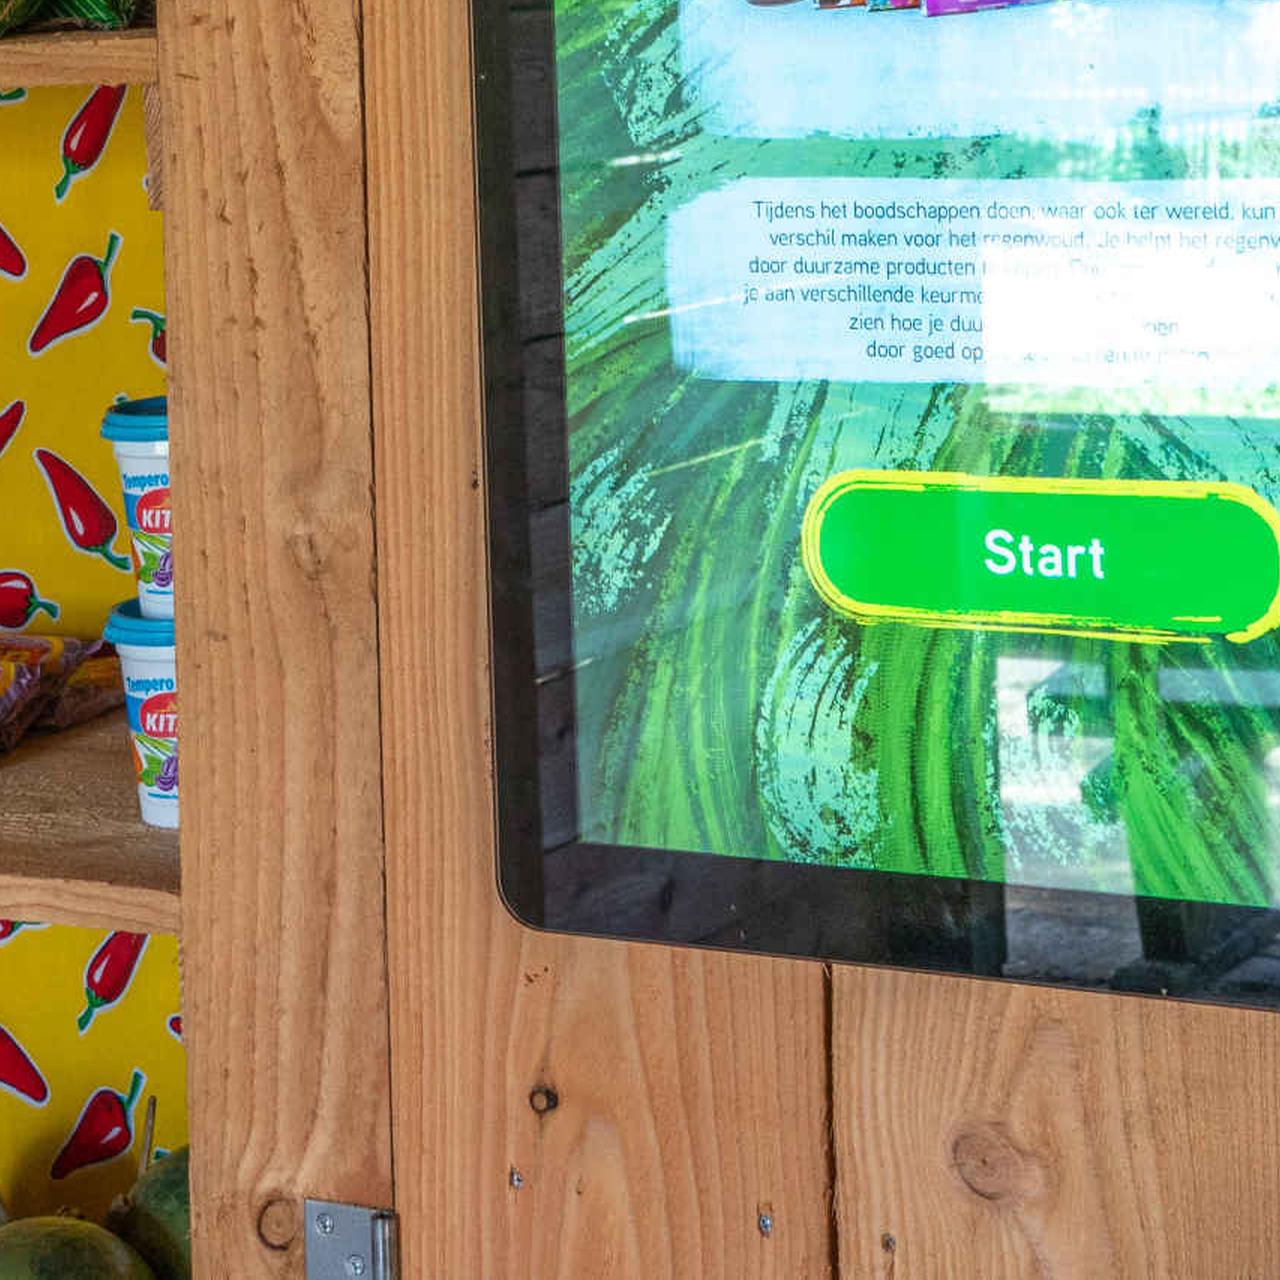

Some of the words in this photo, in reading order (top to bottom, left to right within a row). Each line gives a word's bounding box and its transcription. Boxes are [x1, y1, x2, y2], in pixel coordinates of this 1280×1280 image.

[752, 200, 816, 226] Tijdens
[820, 200, 848, 220] het
[852, 199, 981, 227] boodschappen
[1093, 200, 1126, 221] ook
[1132, 202, 1159, 221] ter
[1241, 201, 1277, 221] kun
[770, 228, 836, 248] verschil
[840, 229, 898, 248] maken
[903, 231, 942, 248] voor
[948, 229, 977, 248] het
[748, 257, 788, 276] door
[792, 257, 881, 277] duurzame
[885, 258, 977, 282] producten
[743, 284, 759, 306] je
[764, 287, 796, 302] aan
[800, 283, 915, 304] verschillende
[848, 314, 885, 332] zien
[890, 315, 924, 333] hoe
[927, 315, 945, 337] je
[866, 340, 906, 360] door
[912, 341, 956, 363] goed
[122, 472, 169, 495] Tempero
[141, 507, 173, 530] KIT
[983, 528, 1106, 580] Start
[126, 676, 175, 695] Tempero
[145, 711, 178, 734] KIT
